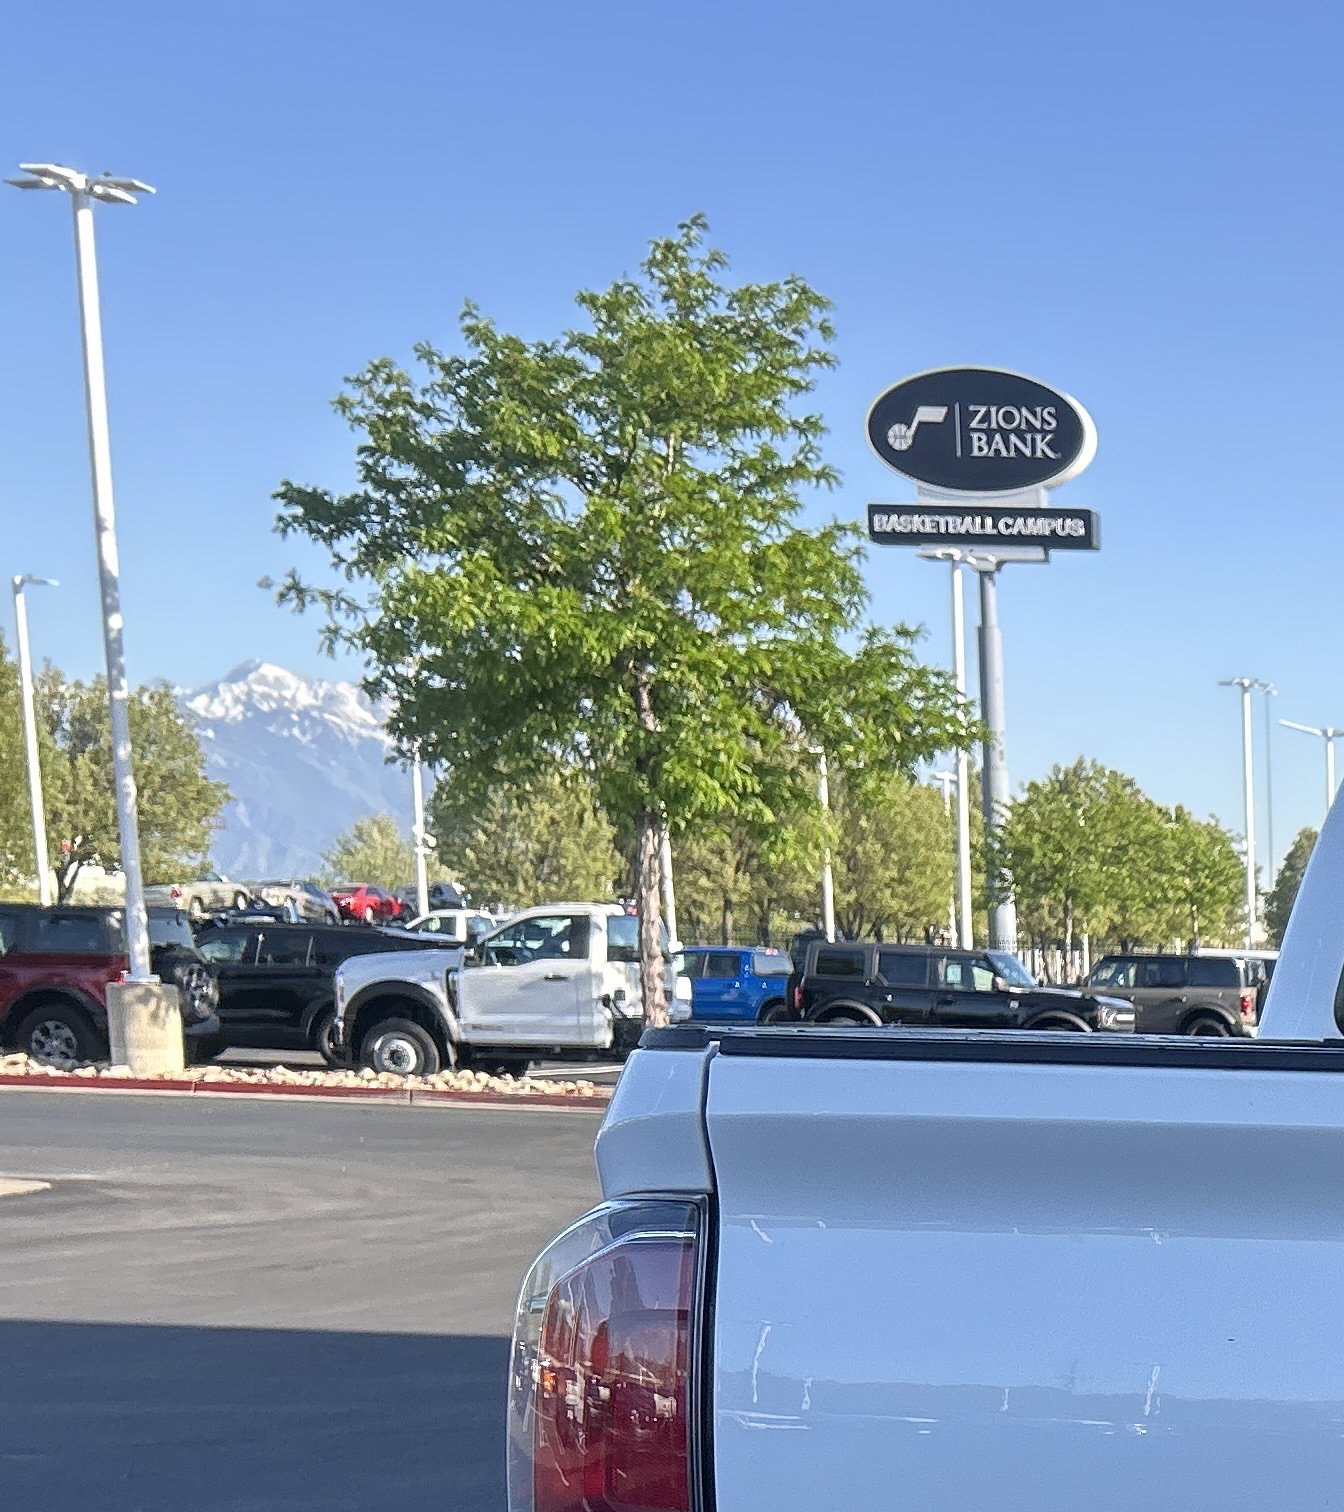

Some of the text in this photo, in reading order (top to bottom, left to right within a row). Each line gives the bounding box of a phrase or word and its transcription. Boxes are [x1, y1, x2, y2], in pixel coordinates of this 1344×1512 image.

[968, 404, 1058, 431] ZIONS
[969, 431, 1062, 460] BANK
[873, 513, 1085, 537] BASKETBALL CAMPUS
